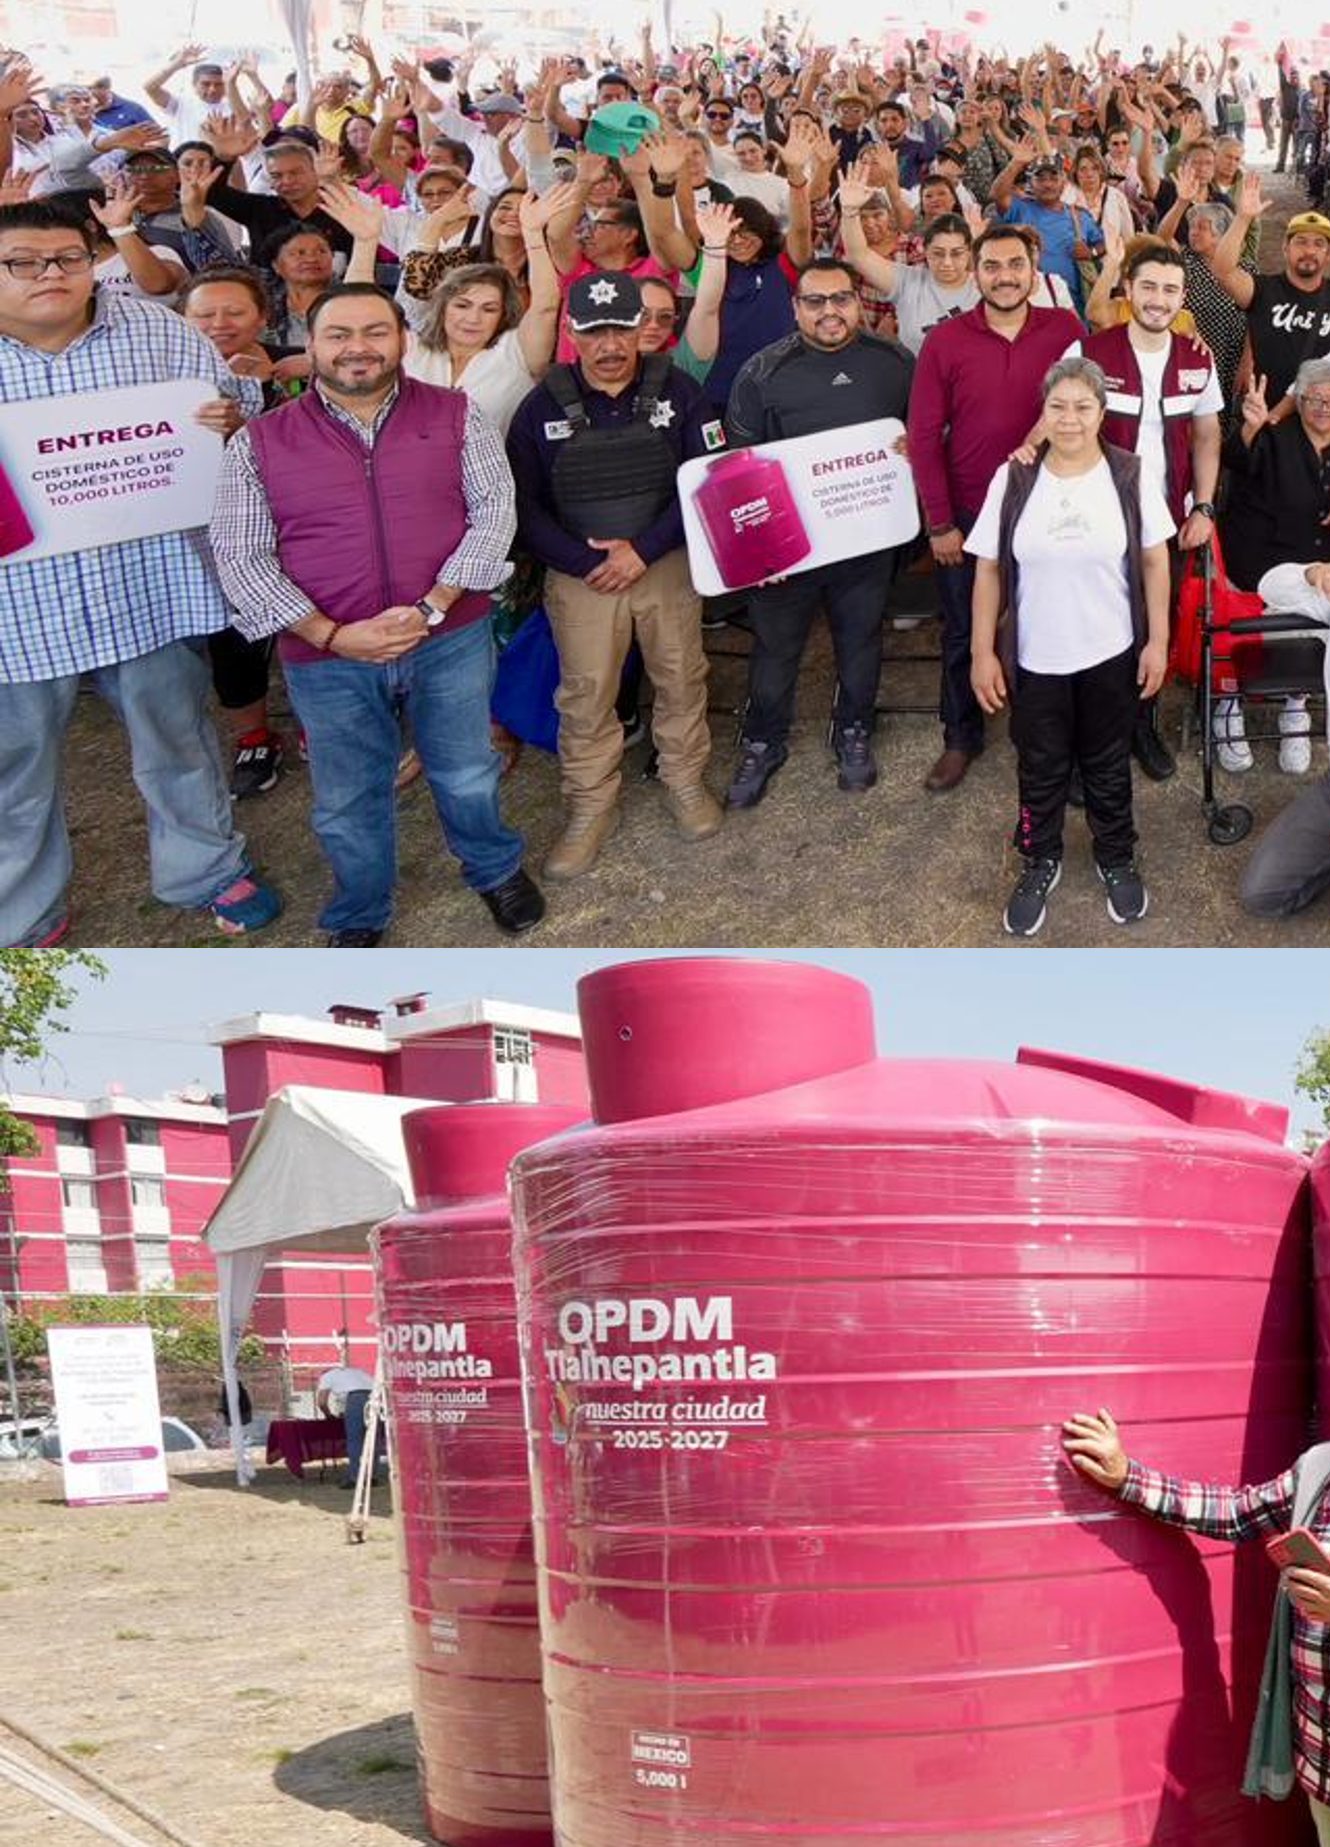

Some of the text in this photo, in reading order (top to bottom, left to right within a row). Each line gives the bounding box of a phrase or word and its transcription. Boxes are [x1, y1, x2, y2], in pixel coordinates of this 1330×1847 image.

[37, 421, 174, 454] ENTREGA
[32, 447, 184, 481] CISTERNA DE USO
[154, 463, 176, 475] DE
[812, 449, 888, 476] ENTREGA
[50, 487, 109, 506] 10,000
[812, 481, 861, 498] CISTERNA
[559, 1296, 733, 1343] OPDM
[383, 1322, 467, 1353] OPDM
[545, 1345, 777, 1391] Tlalnepantla
[584, 1396, 766, 1420] nuestra ciudad
[635, 1769, 678, 1788] 5,000
